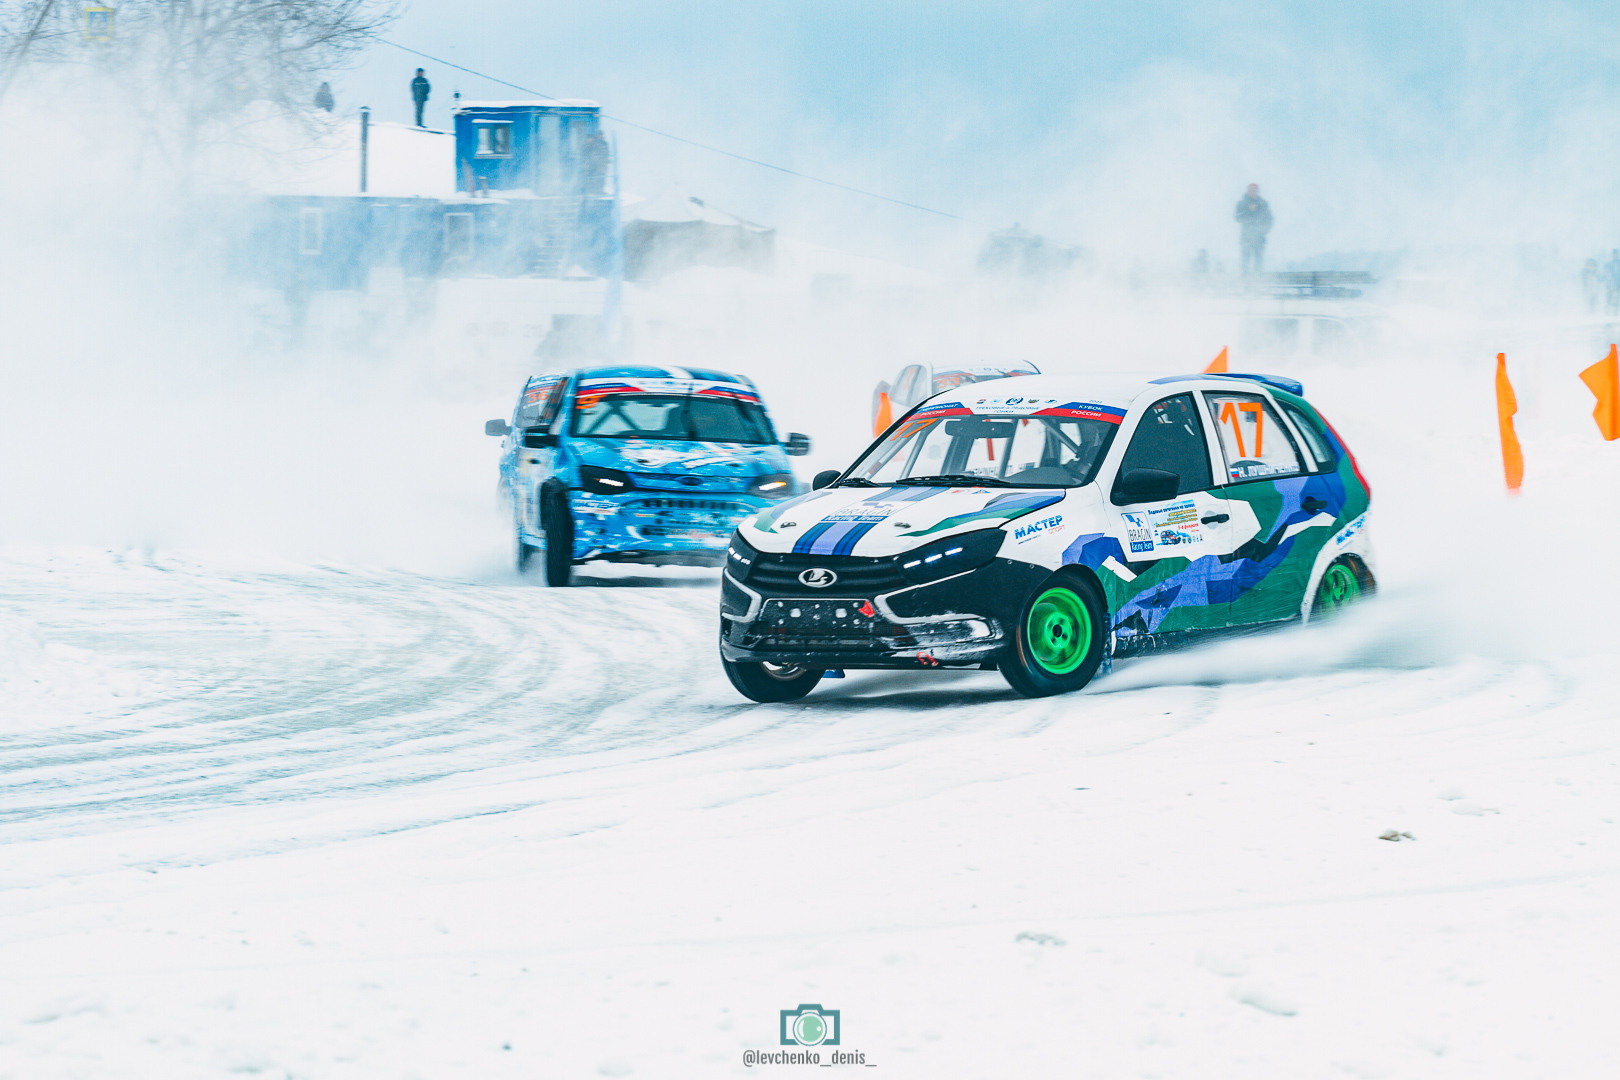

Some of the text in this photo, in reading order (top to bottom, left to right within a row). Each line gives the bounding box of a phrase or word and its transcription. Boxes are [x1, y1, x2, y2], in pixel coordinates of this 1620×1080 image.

[936, 376, 961, 389] 33
[527, 390, 549, 404] 36
[890, 418, 939, 441] 17
[1220, 402, 1264, 458] 17
[1014, 514, 1063, 540] МАСТЕР
[1128, 528, 1152, 542] BRAGIN
[1131, 540, 1153, 552] Racing Team
